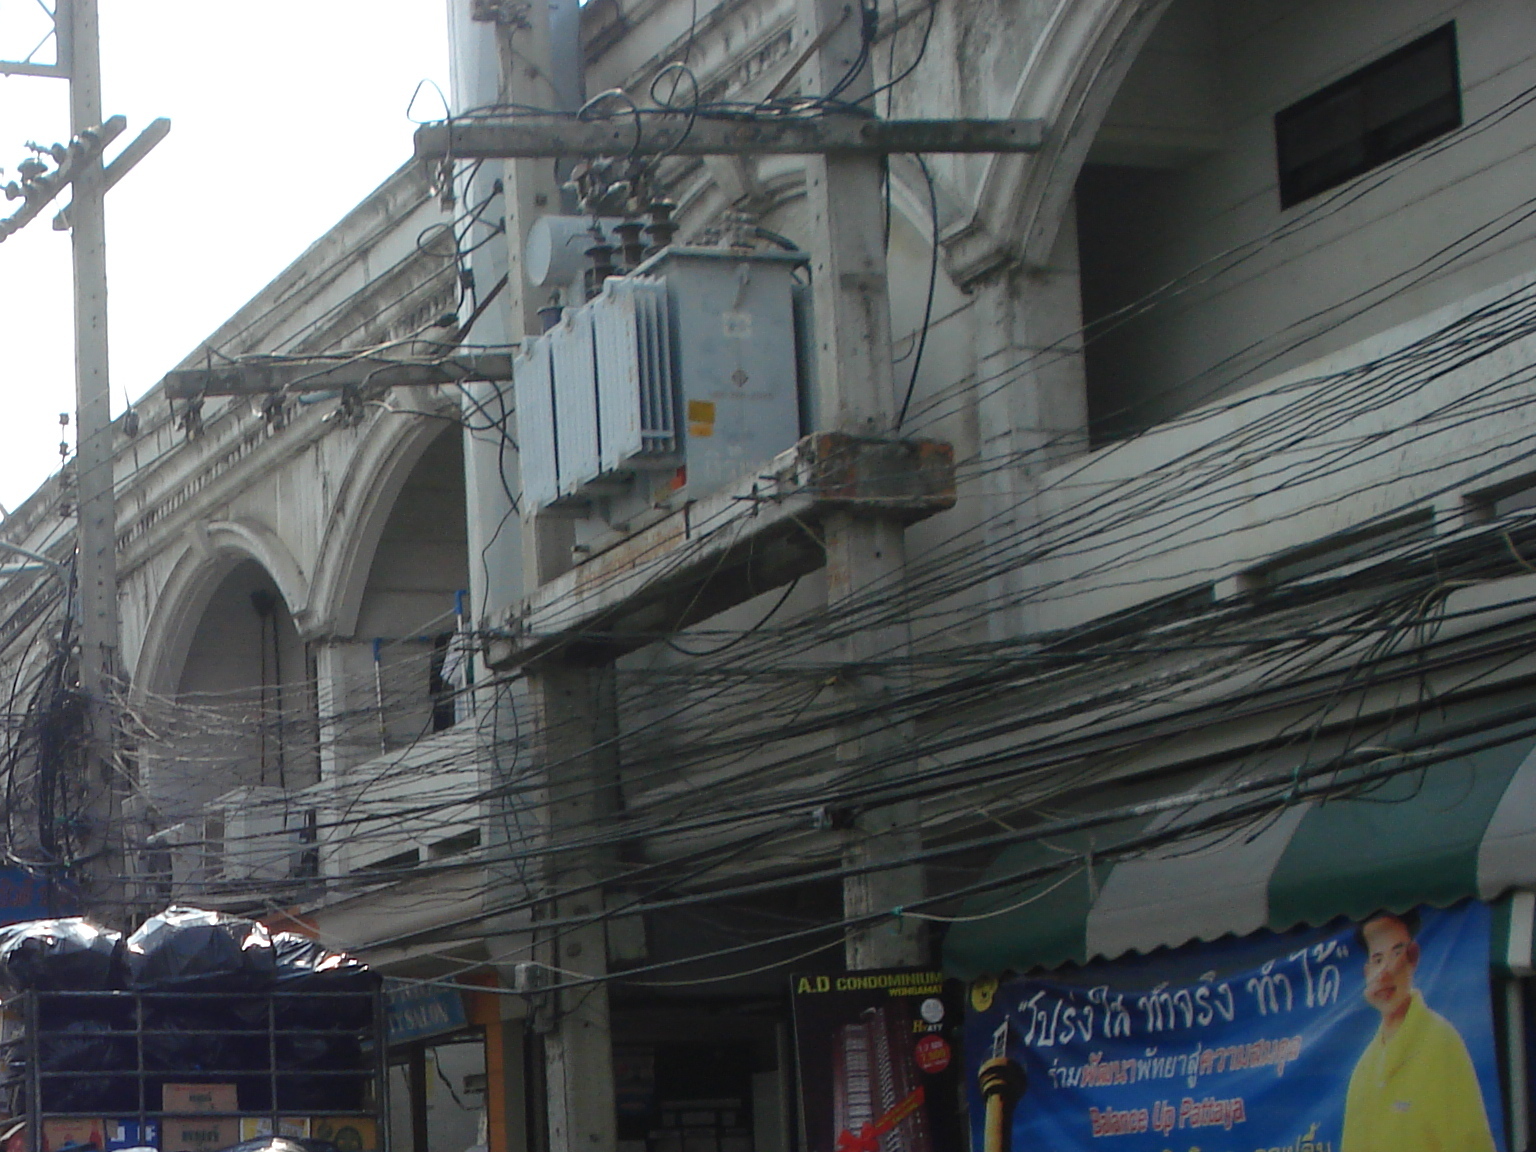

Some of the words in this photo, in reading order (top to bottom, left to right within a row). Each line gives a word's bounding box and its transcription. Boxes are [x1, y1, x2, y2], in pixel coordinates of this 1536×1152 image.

[798, 976, 830, 994] A.D
[1090, 1107, 1148, 1137] Balance
[1153, 1101, 1175, 1136] Up
[1179, 1097, 1246, 1130] Pattaya
